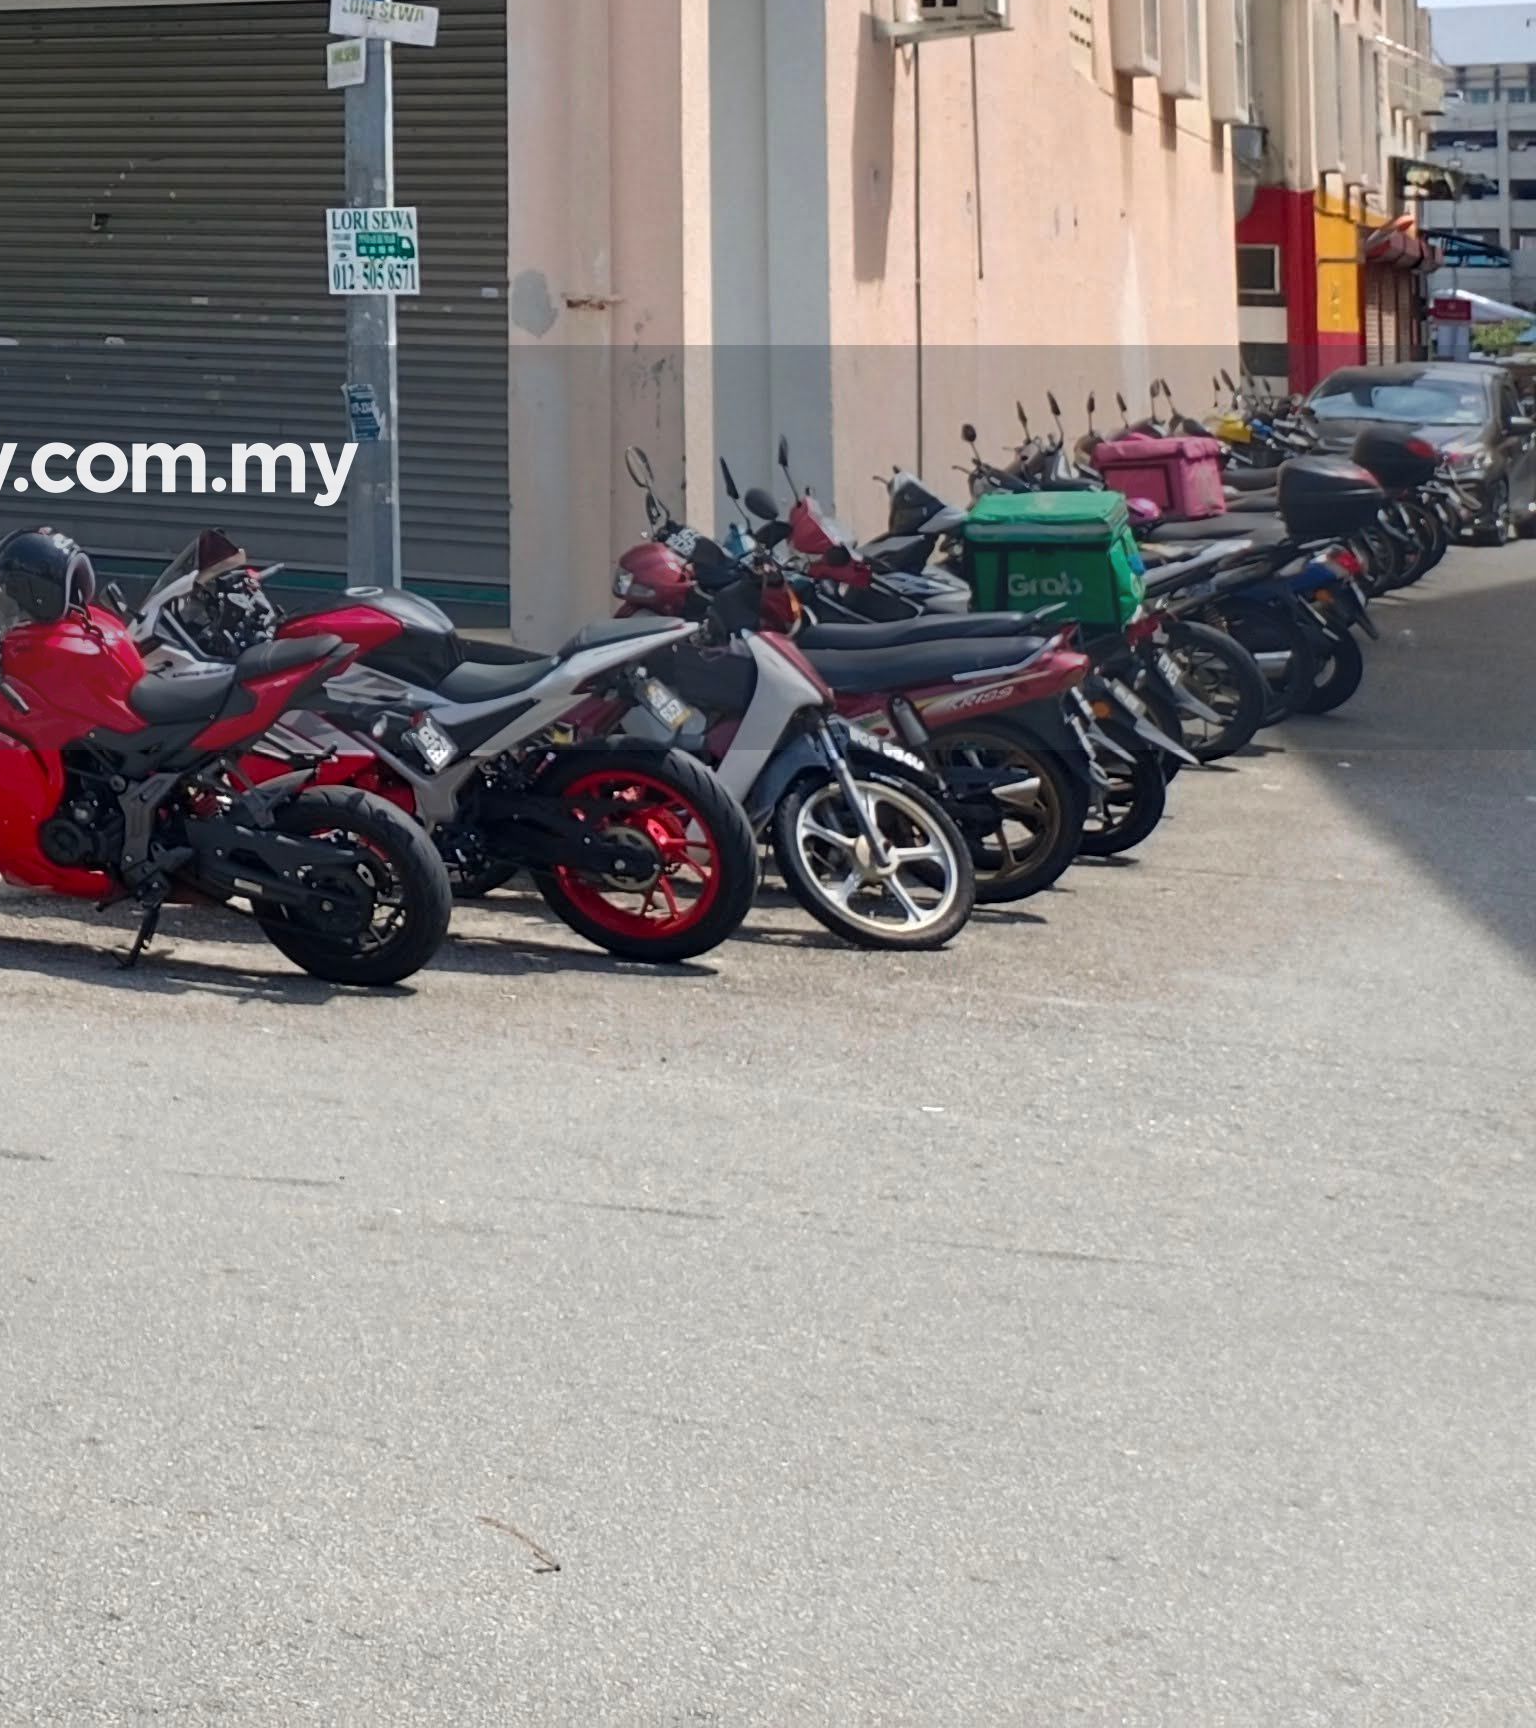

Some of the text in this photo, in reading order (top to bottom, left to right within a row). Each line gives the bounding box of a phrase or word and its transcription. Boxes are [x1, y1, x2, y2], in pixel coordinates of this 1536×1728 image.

[332, 210, 413, 230] LORI SEWA
[388, 263, 416, 290] 8571
[1008, 571, 1083, 597] Grab
